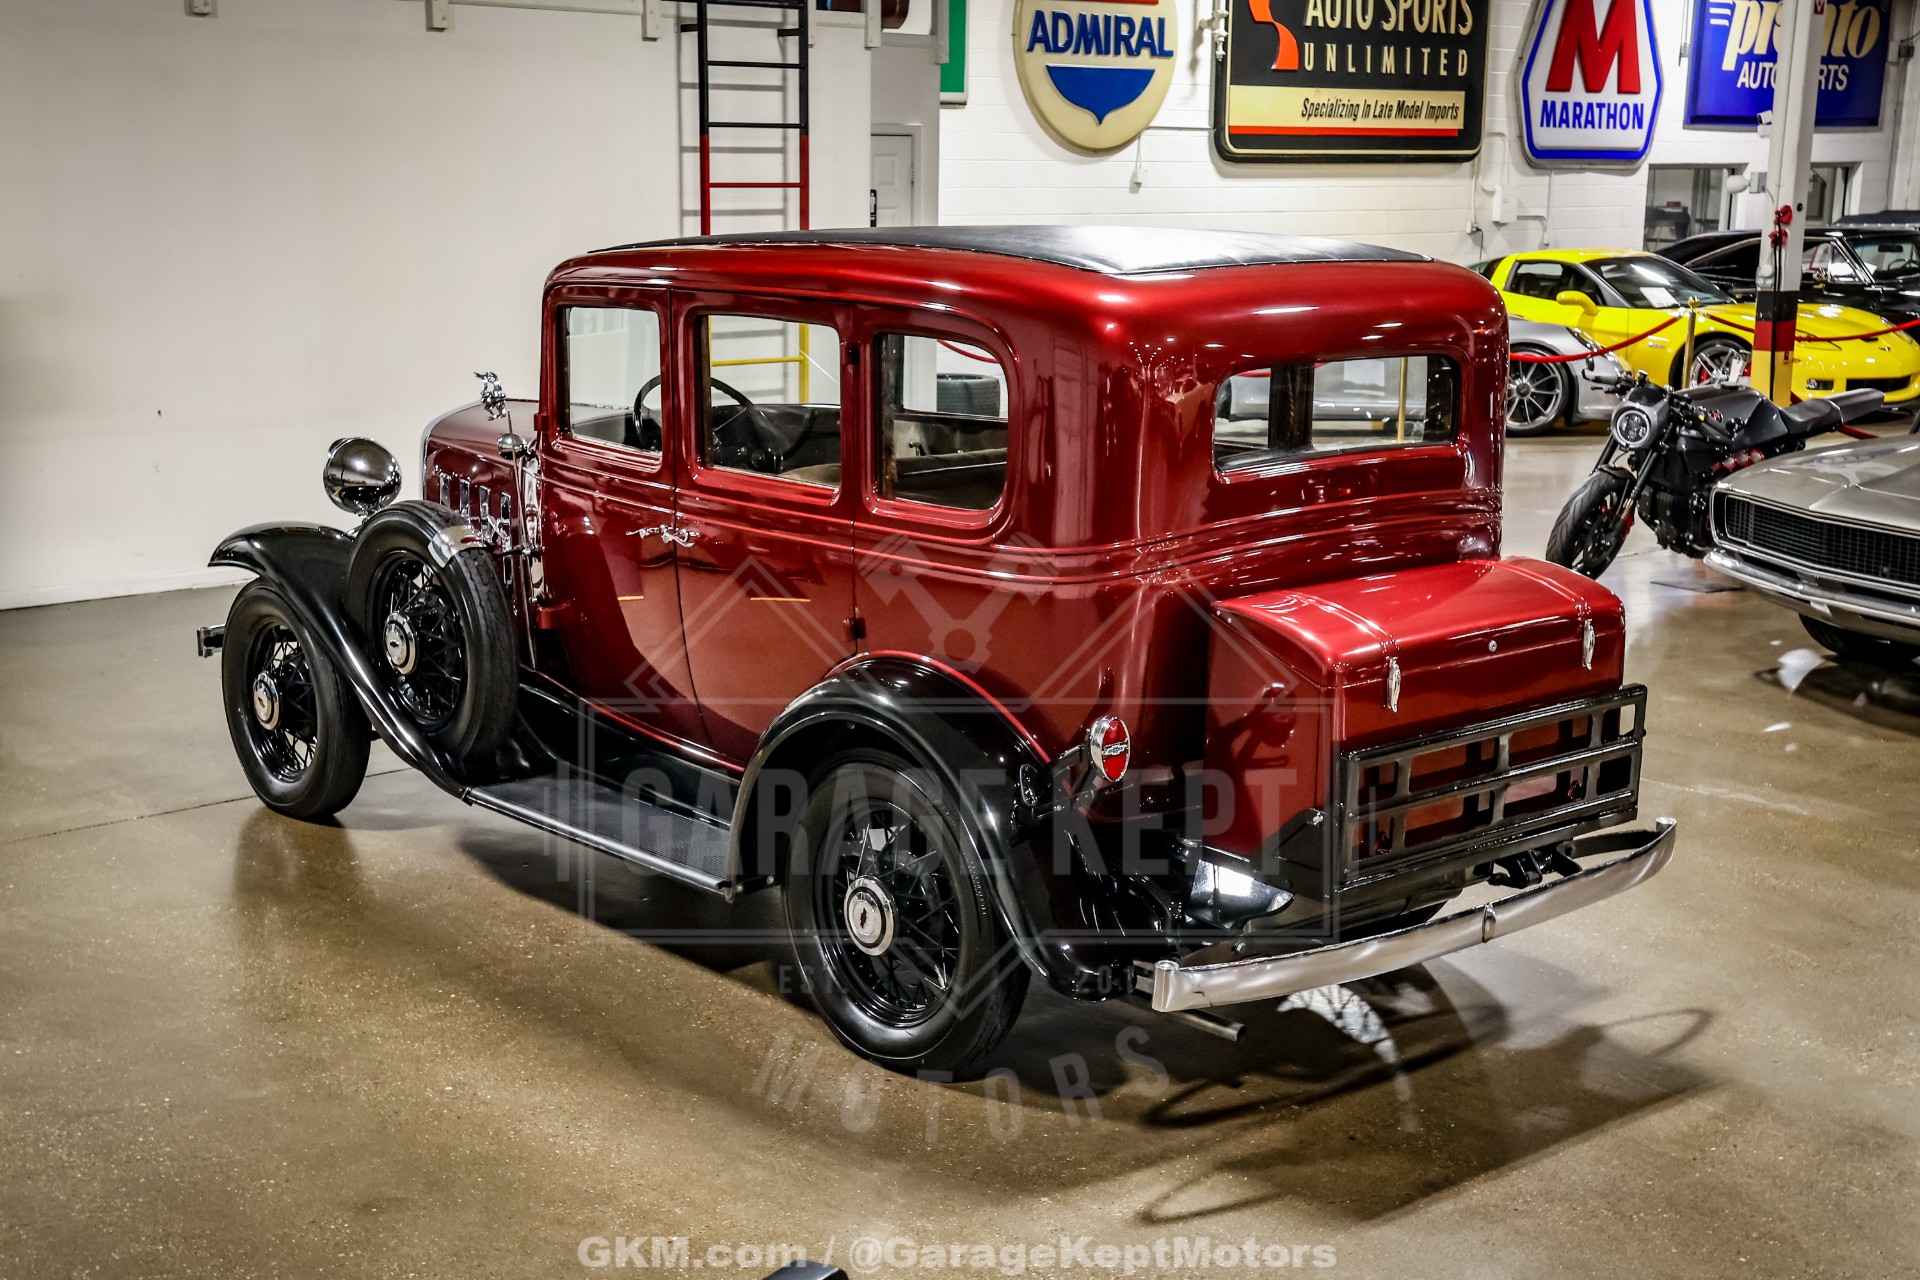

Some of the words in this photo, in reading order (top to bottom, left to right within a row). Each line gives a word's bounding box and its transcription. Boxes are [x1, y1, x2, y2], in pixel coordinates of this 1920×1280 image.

[1026, 10, 1174, 57] ADMIRAL
[1304, 42, 1468, 76] UNLIMITED
[1301, 98, 1359, 121] Specializing
[1362, 100, 1371, 119] In
[1373, 100, 1392, 119] Late
[1395, 100, 1422, 119] Model
[1425, 101, 1459, 122] Imports
[1540, 99, 1644, 130] MARATHON
